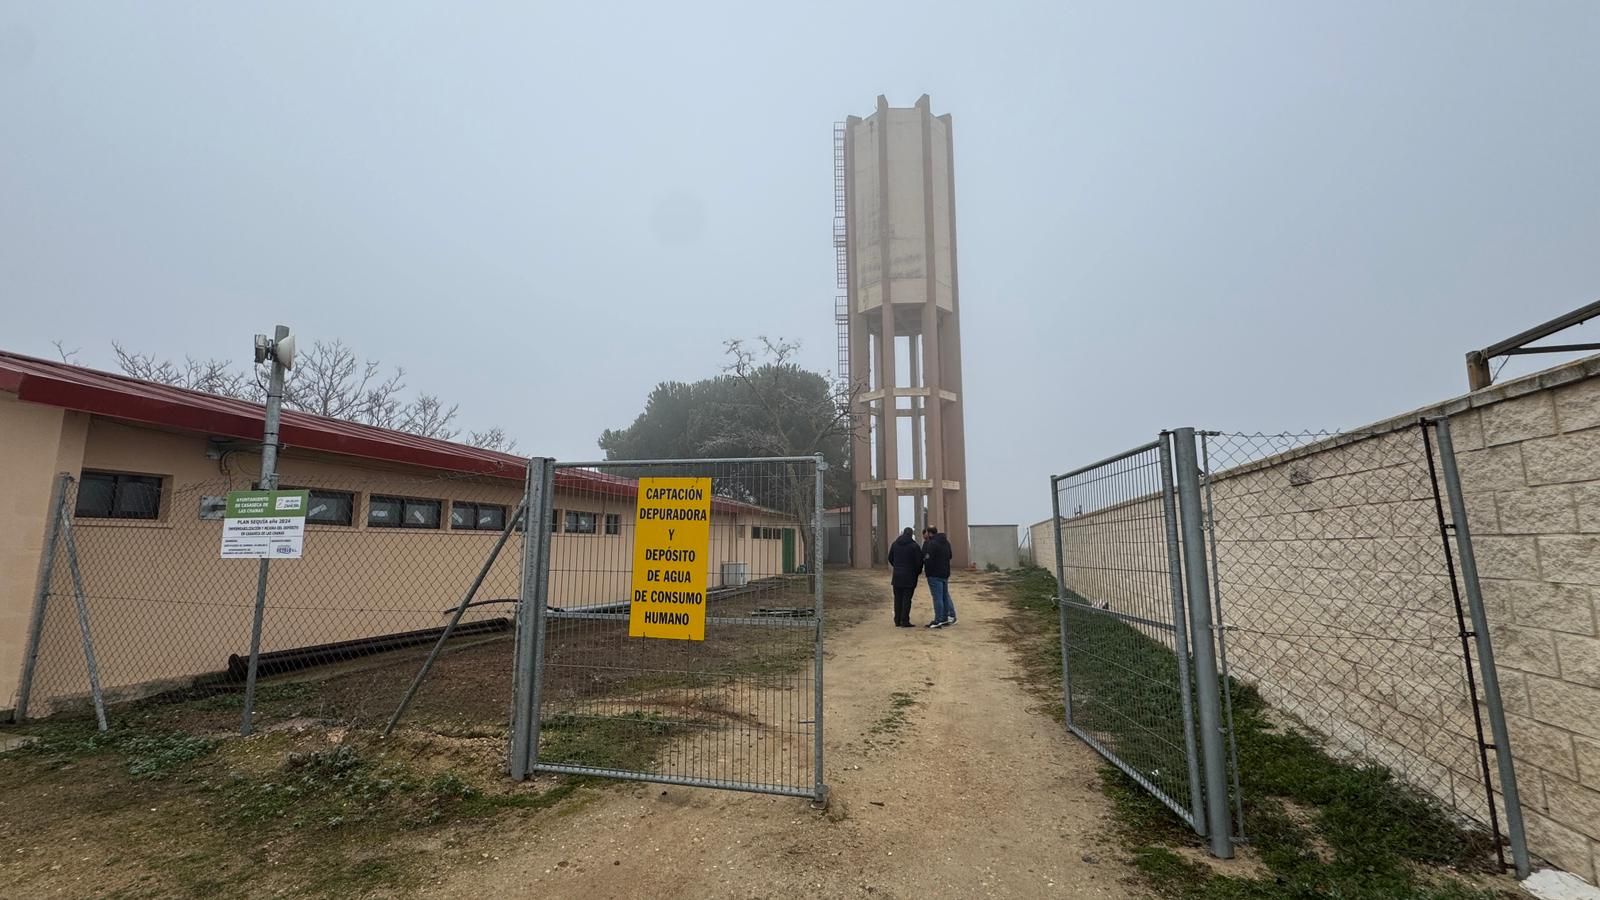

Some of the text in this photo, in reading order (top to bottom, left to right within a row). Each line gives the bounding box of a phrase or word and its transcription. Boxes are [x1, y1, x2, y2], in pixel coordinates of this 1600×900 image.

[646, 485, 703, 500] CAPTACIÓN
[640, 508, 707, 521] DEPURADORA
[668, 529, 675, 541] Y
[645, 546, 695, 562] DEPÓSITO
[647, 570, 691, 583] DE AGUA
[634, 590, 703, 605] DE CONSUMO
[644, 611, 690, 626] HUMANO
